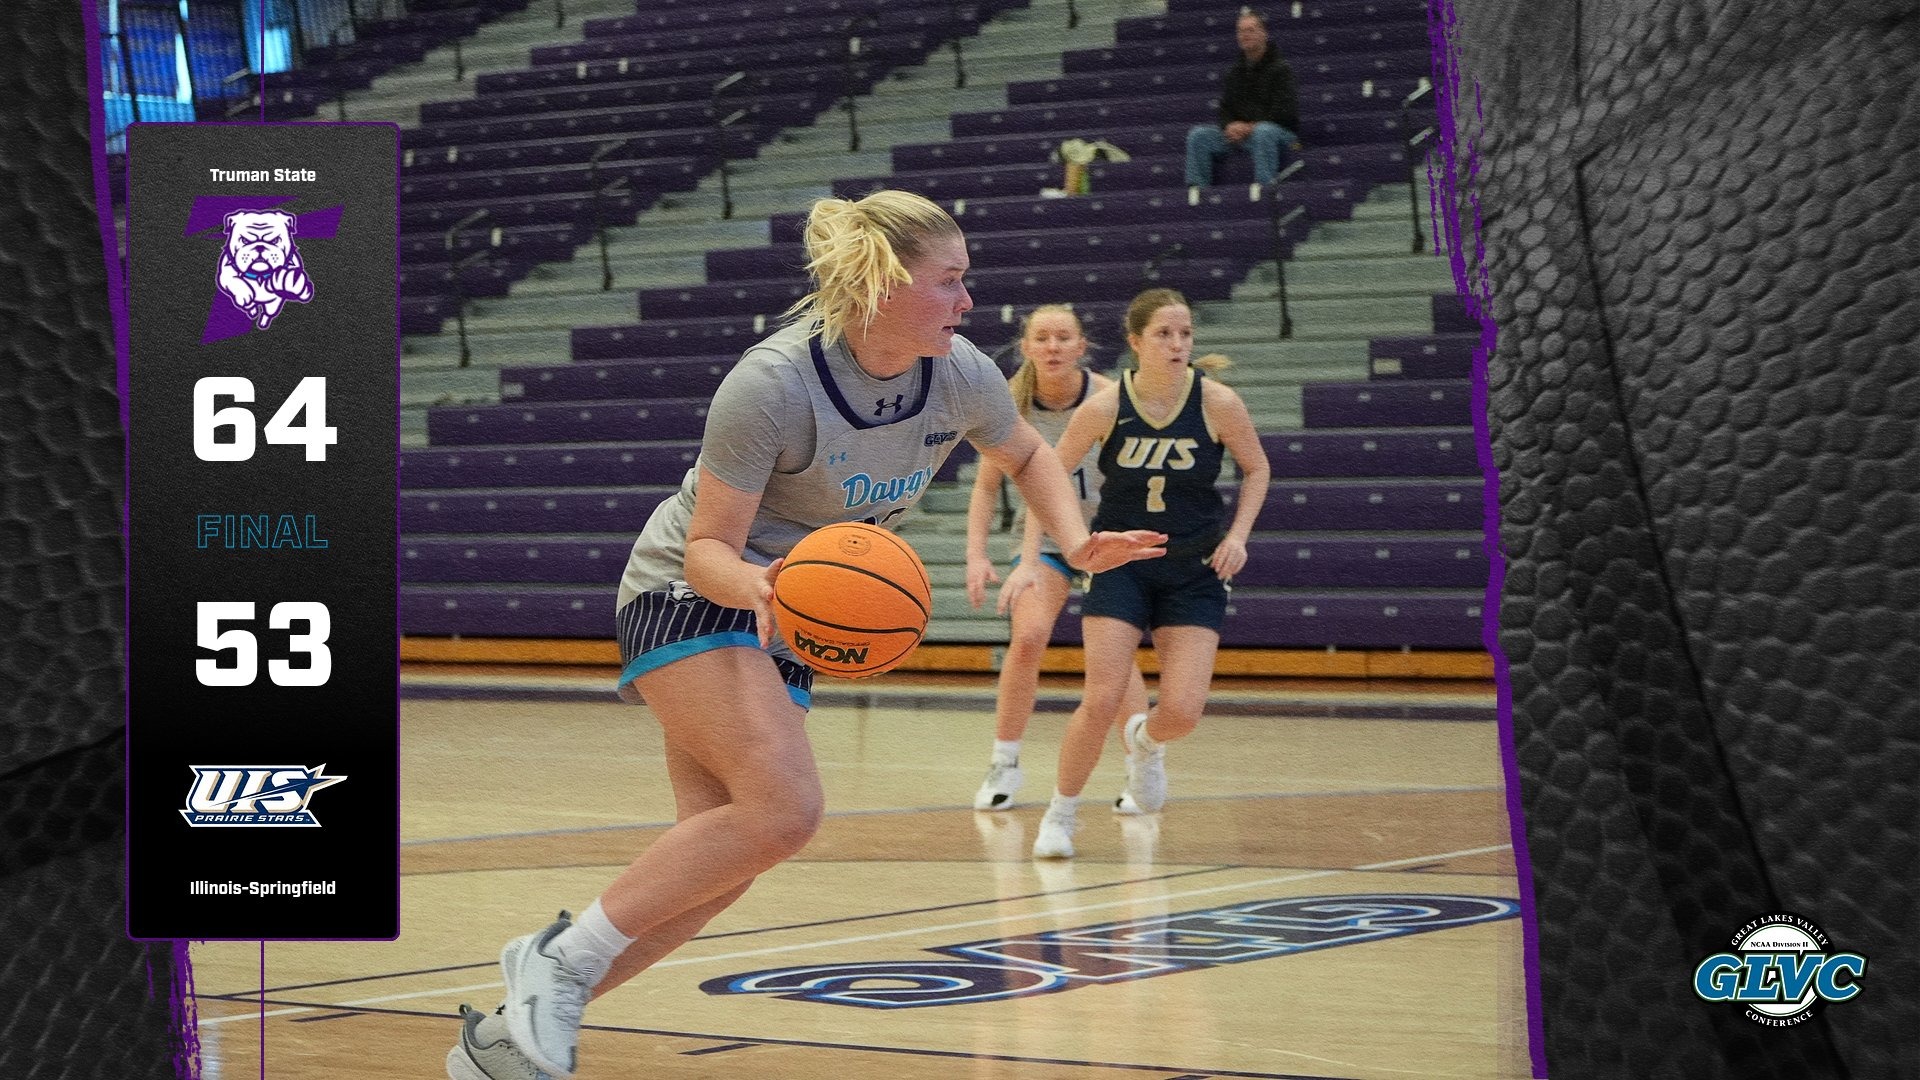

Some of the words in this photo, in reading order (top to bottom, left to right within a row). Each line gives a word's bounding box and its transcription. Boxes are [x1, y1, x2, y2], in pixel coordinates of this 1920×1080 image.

[1116, 436, 1199, 470] UIS
[841, 464, 933, 510] Dawgs
[1146, 475, 1167, 513] 1
[794, 630, 869, 664] NCAA
